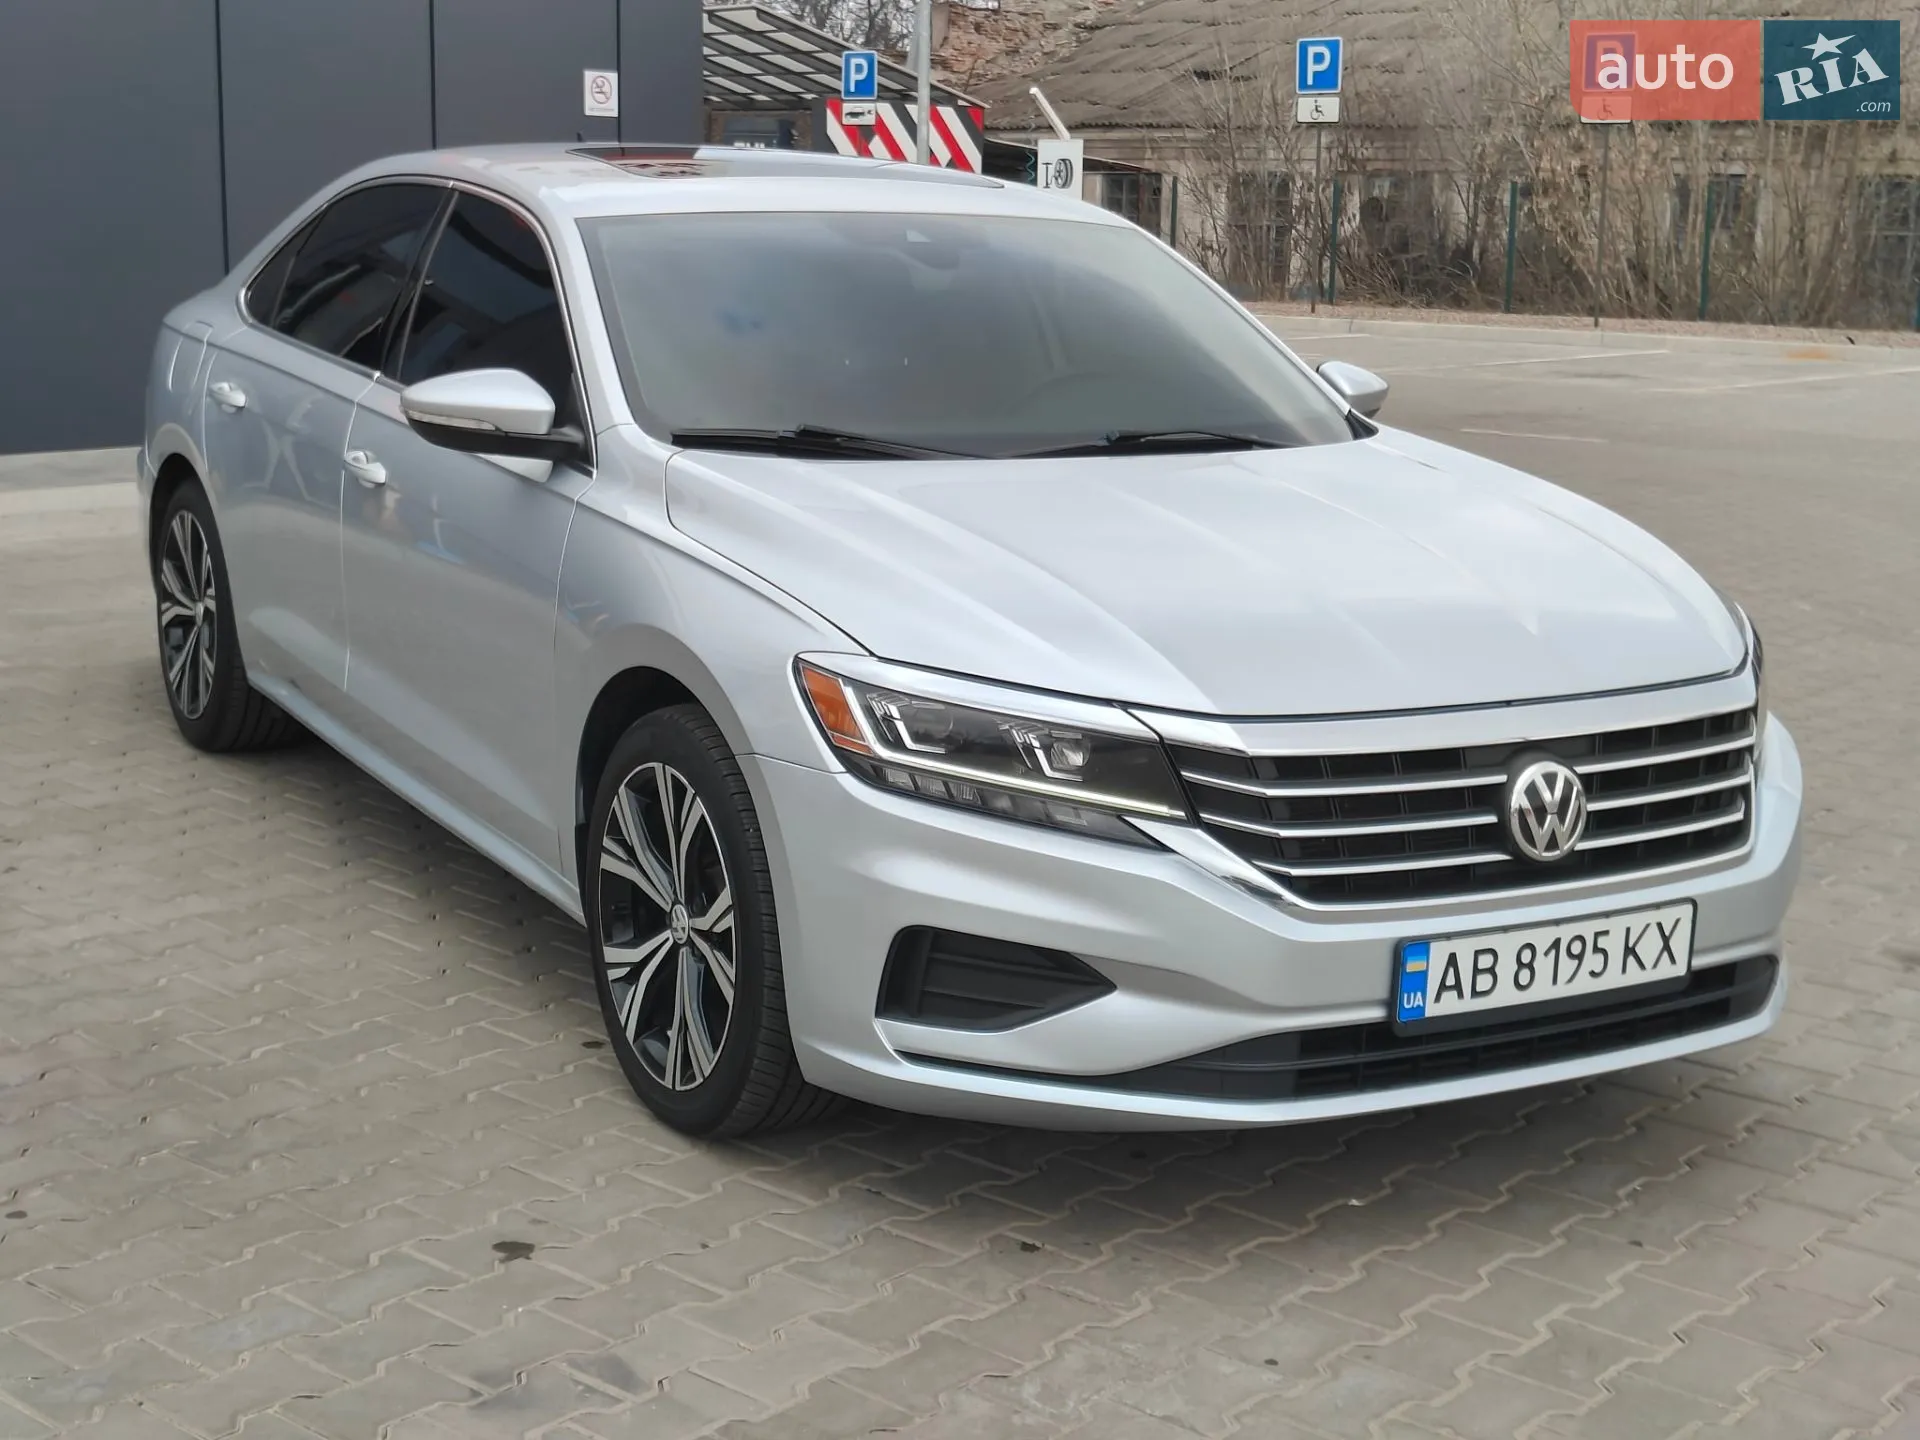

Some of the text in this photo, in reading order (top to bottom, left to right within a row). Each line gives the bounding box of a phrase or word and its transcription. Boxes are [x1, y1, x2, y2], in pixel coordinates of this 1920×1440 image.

[849, 58, 869, 93] P
[1307, 45, 1331, 86] P
[1433, 917, 1682, 1004] AB 8195 KX
[1403, 991, 1424, 1009] UA
